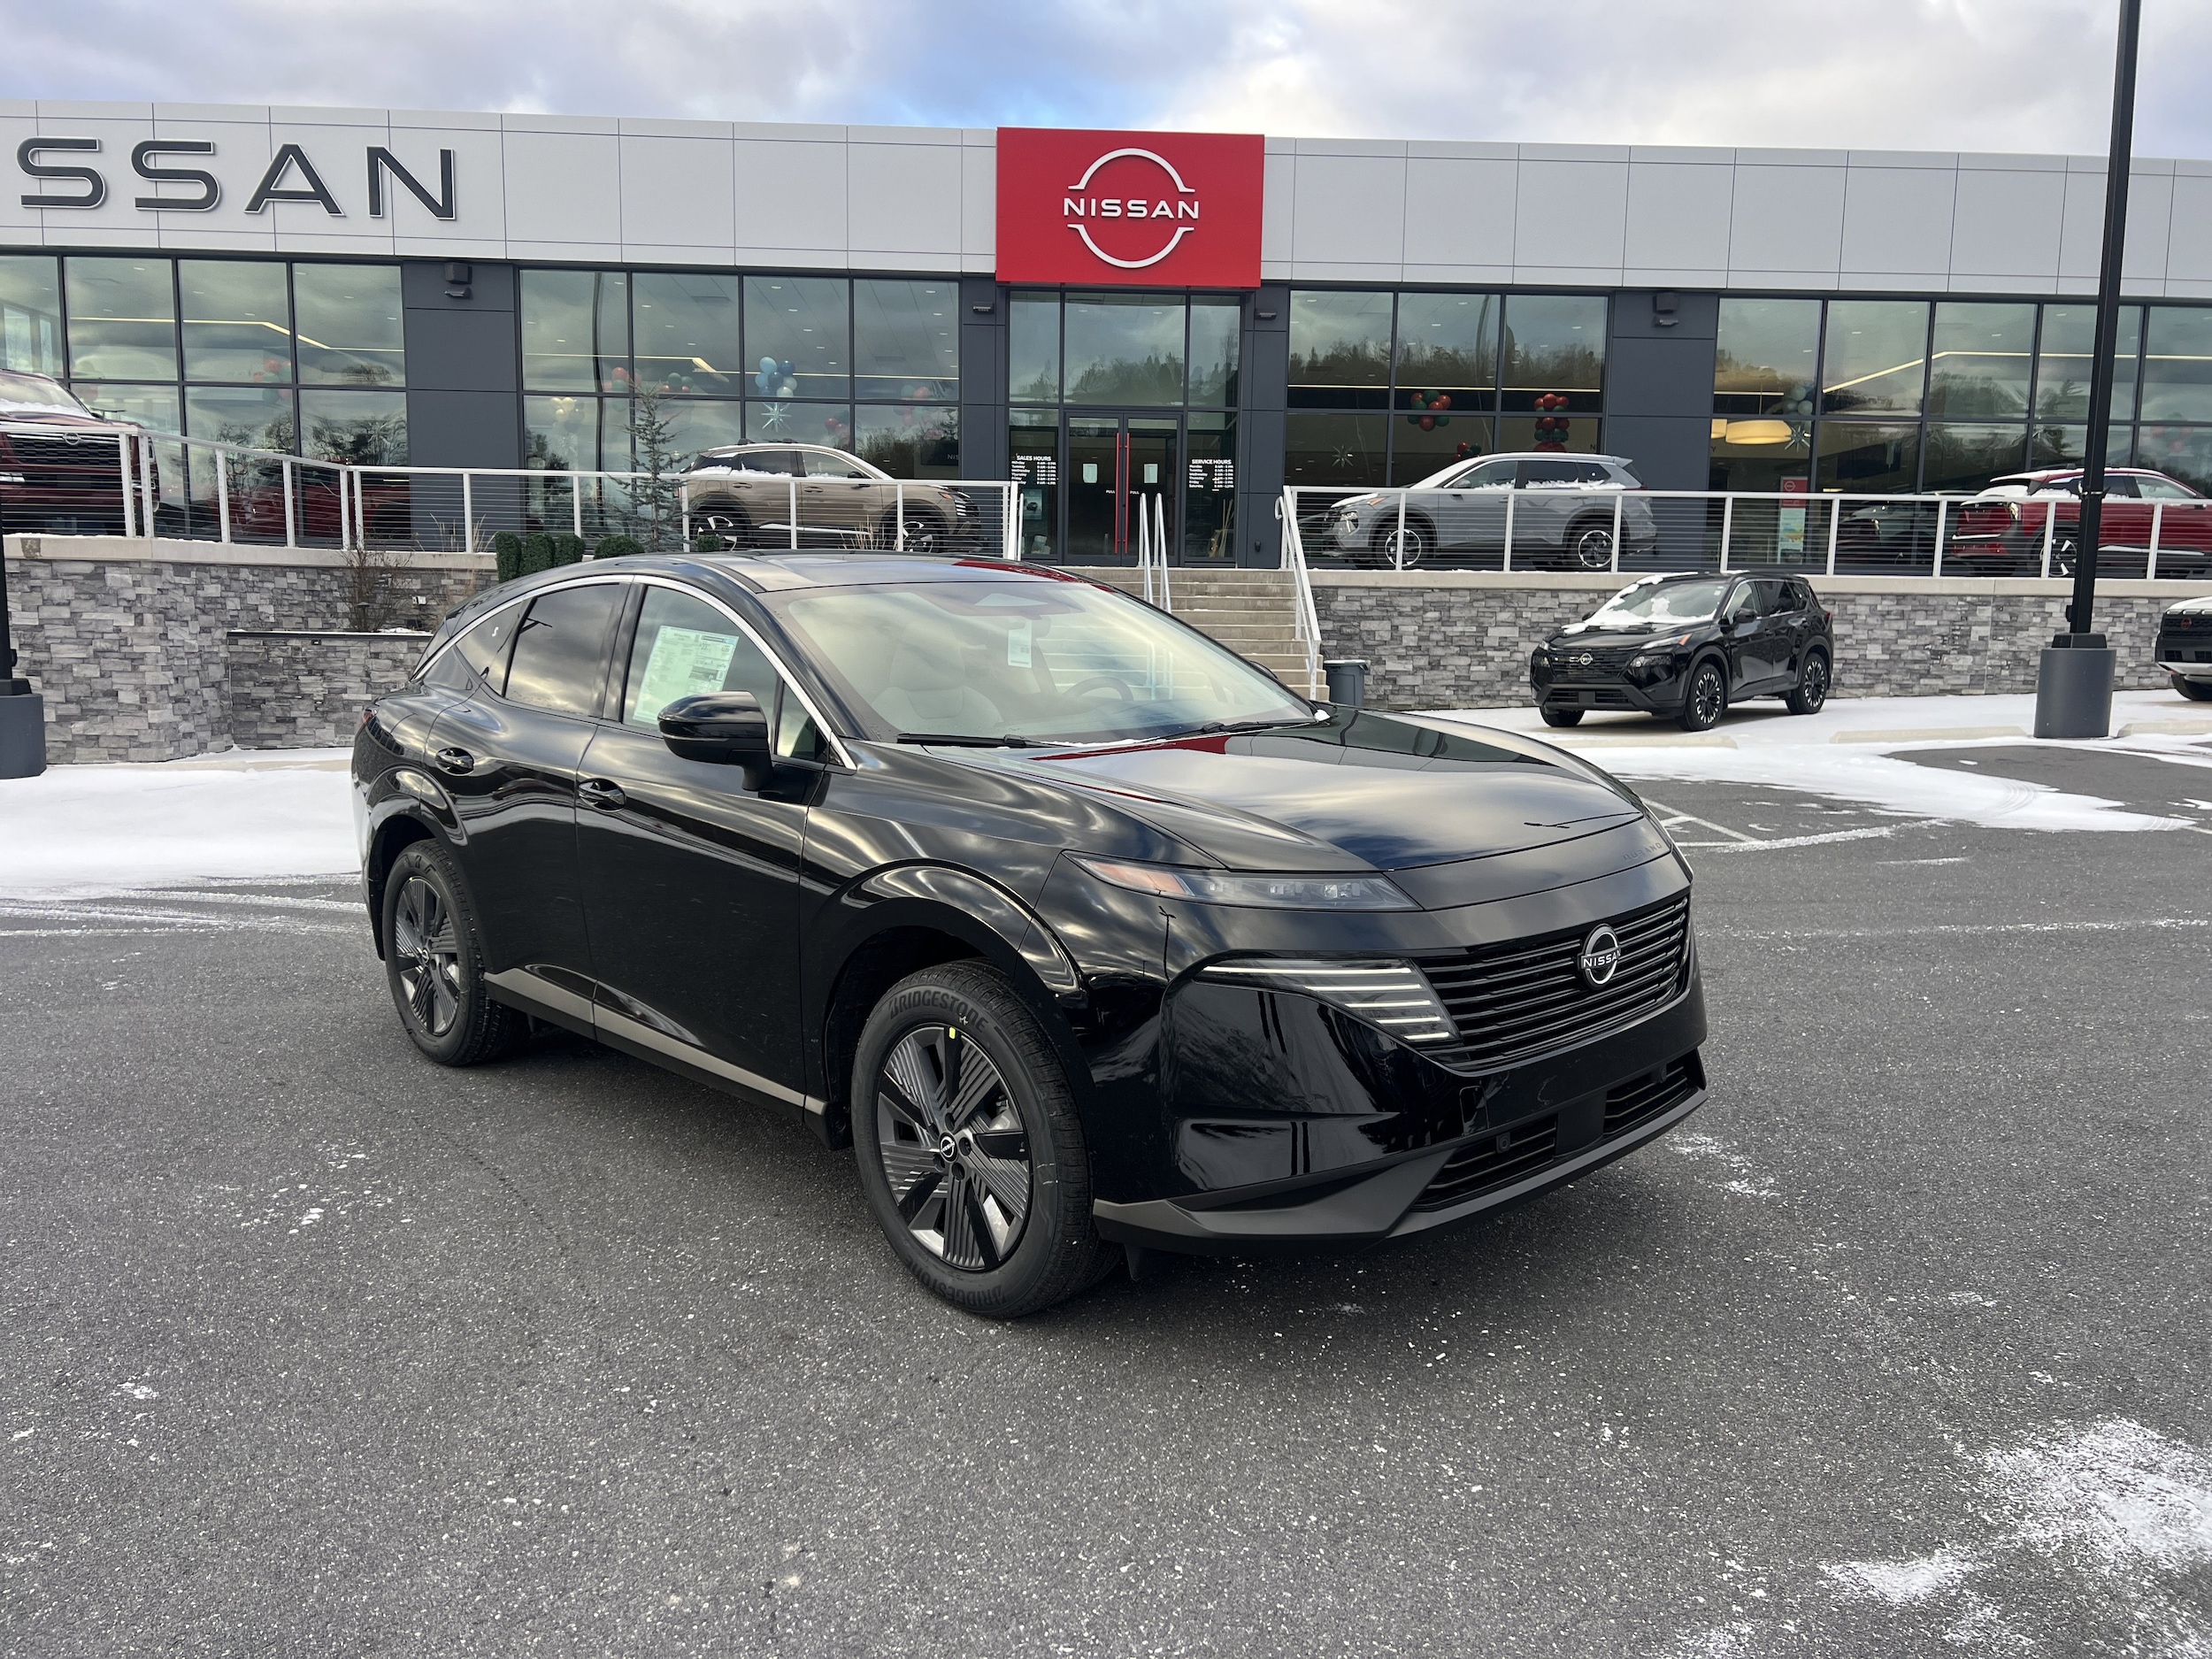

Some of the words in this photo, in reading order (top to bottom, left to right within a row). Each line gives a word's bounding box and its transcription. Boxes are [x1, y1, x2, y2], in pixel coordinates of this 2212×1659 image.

[16, 136, 457, 220] SSAN
[1064, 197, 1199, 219] NISSAN
[1623, 842, 1663, 861] MURANO
[888, 990, 989, 1033] BRIDGESTONE
